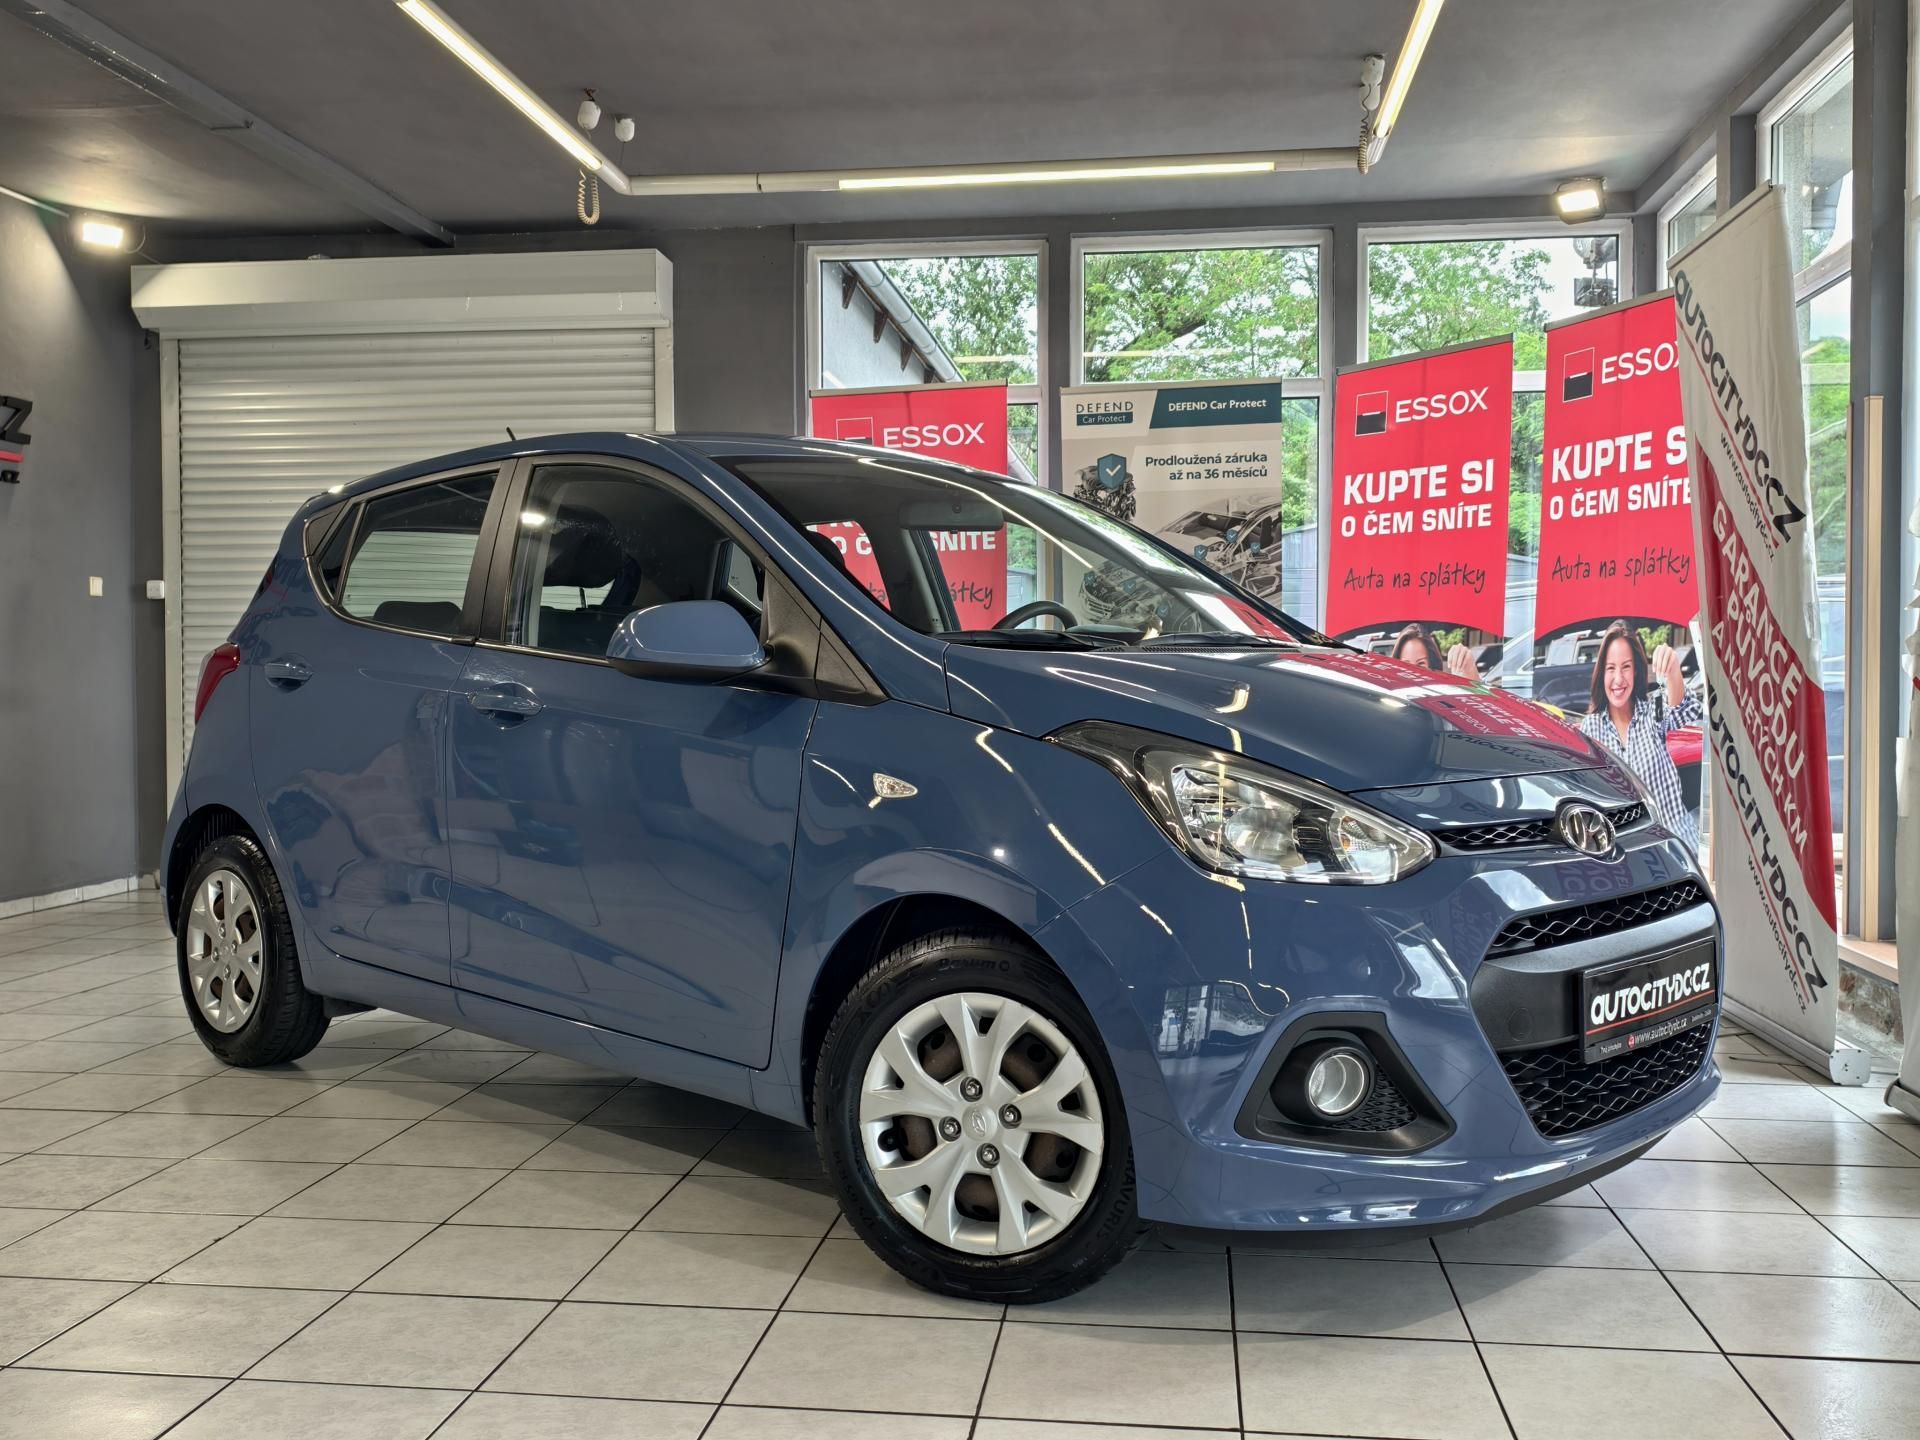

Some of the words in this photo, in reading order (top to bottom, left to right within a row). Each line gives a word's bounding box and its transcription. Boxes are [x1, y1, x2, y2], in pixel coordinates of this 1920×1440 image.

[1076, 401, 1134, 414] DEFEND
[1097, 414, 1126, 423] Protect
[1168, 402, 1207, 412] DEFEND
[1210, 401, 1226, 410] Car
[1229, 399, 1267, 409] Protect
[1395, 387, 1489, 423] ESSOX
[883, 422, 985, 448] ESSOX
[1145, 453, 1222, 468] Prodloužená
[1225, 452, 1268, 464] záruka
[1551, 432, 1653, 483] KUPTE
[1666, 426, 1687, 466] S
[1169, 468, 1184, 481] až
[1186, 471, 1200, 480] na
[1204, 469, 1219, 479] 36
[1222, 466, 1268, 479] měsíců
[1343, 465, 1447, 506] KUPTE
[1461, 458, 1495, 494] SI
[1549, 495, 1564, 520] O
[1571, 487, 1618, 517] ČEM
[1627, 475, 1691, 510] SNÍTE
[1341, 516, 1356, 537] O
[1363, 509, 1413, 536] ČEM
[1421, 502, 1492, 532] SNÍTE
[1344, 567, 1384, 591] Auta
[1393, 571, 1411, 588] na
[1419, 562, 1486, 594] splátky
[1552, 555, 1591, 583] Auta
[1599, 560, 1616, 578] na
[1625, 547, 1691, 578] splátky
[1713, 501, 1803, 703] GARANCE
[1727, 590, 1805, 780] PŮVODU
[1711, 619, 1725, 649] A
[1783, 791, 1808, 856] KM
[1747, 854, 1807, 1015] www.autocitydc.cz
